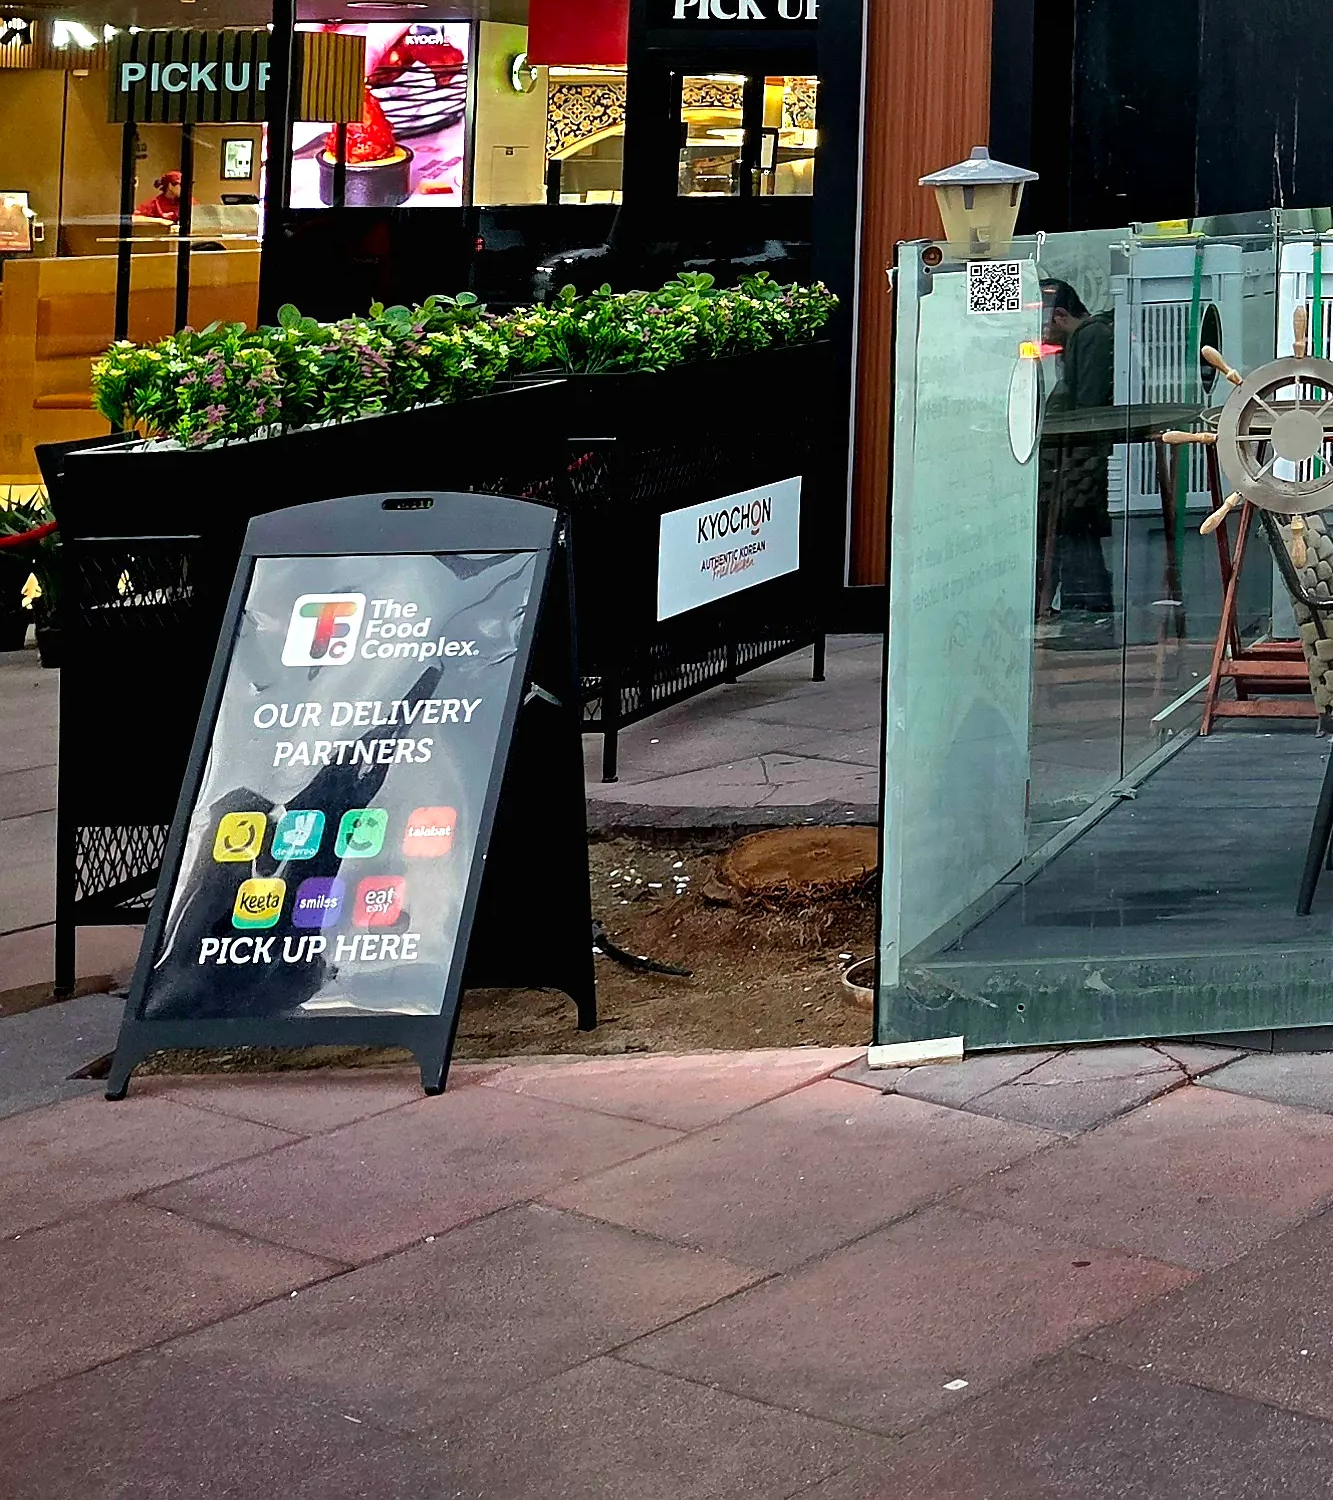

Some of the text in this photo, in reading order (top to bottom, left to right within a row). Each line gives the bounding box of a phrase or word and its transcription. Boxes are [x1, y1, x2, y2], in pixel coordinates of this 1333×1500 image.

[697, 497, 772, 544] KYOCHON
[700, 541, 766, 572] AUTHENTIC KOREAN
[370, 599, 418, 619] The
[365, 618, 432, 639] Food
[253, 698, 483, 729] OUR DELIVERY
[272, 737, 434, 767] PARTNERS
[407, 825, 451, 837] talabat
[240, 892, 280, 913] keeta
[365, 886, 395, 903] eat
[365, 902, 391, 914] easy
[198, 932, 421, 965] PICK UP HERE
